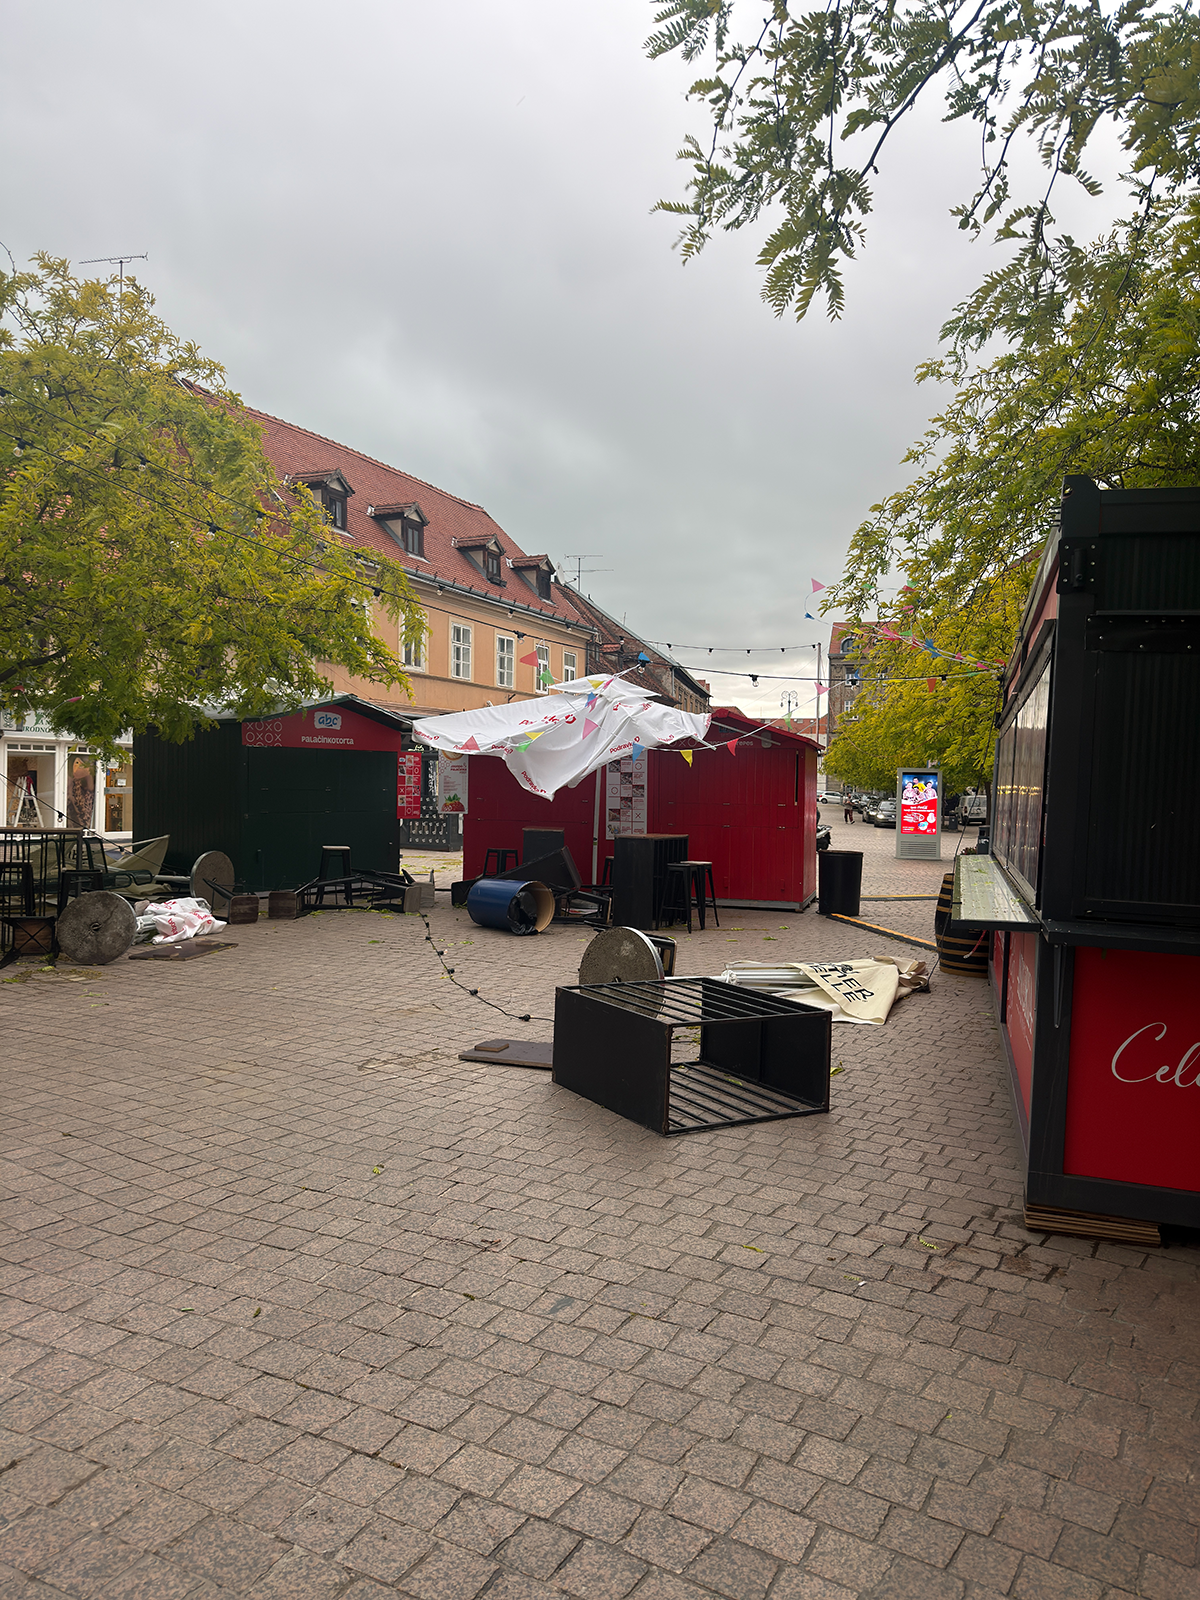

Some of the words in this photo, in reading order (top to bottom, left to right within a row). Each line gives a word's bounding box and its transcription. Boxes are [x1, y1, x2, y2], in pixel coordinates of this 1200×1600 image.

[318, 714, 338, 726] abc
[609, 741, 635, 754] Podravk
[1111, 1021, 1200, 1088] Cel
